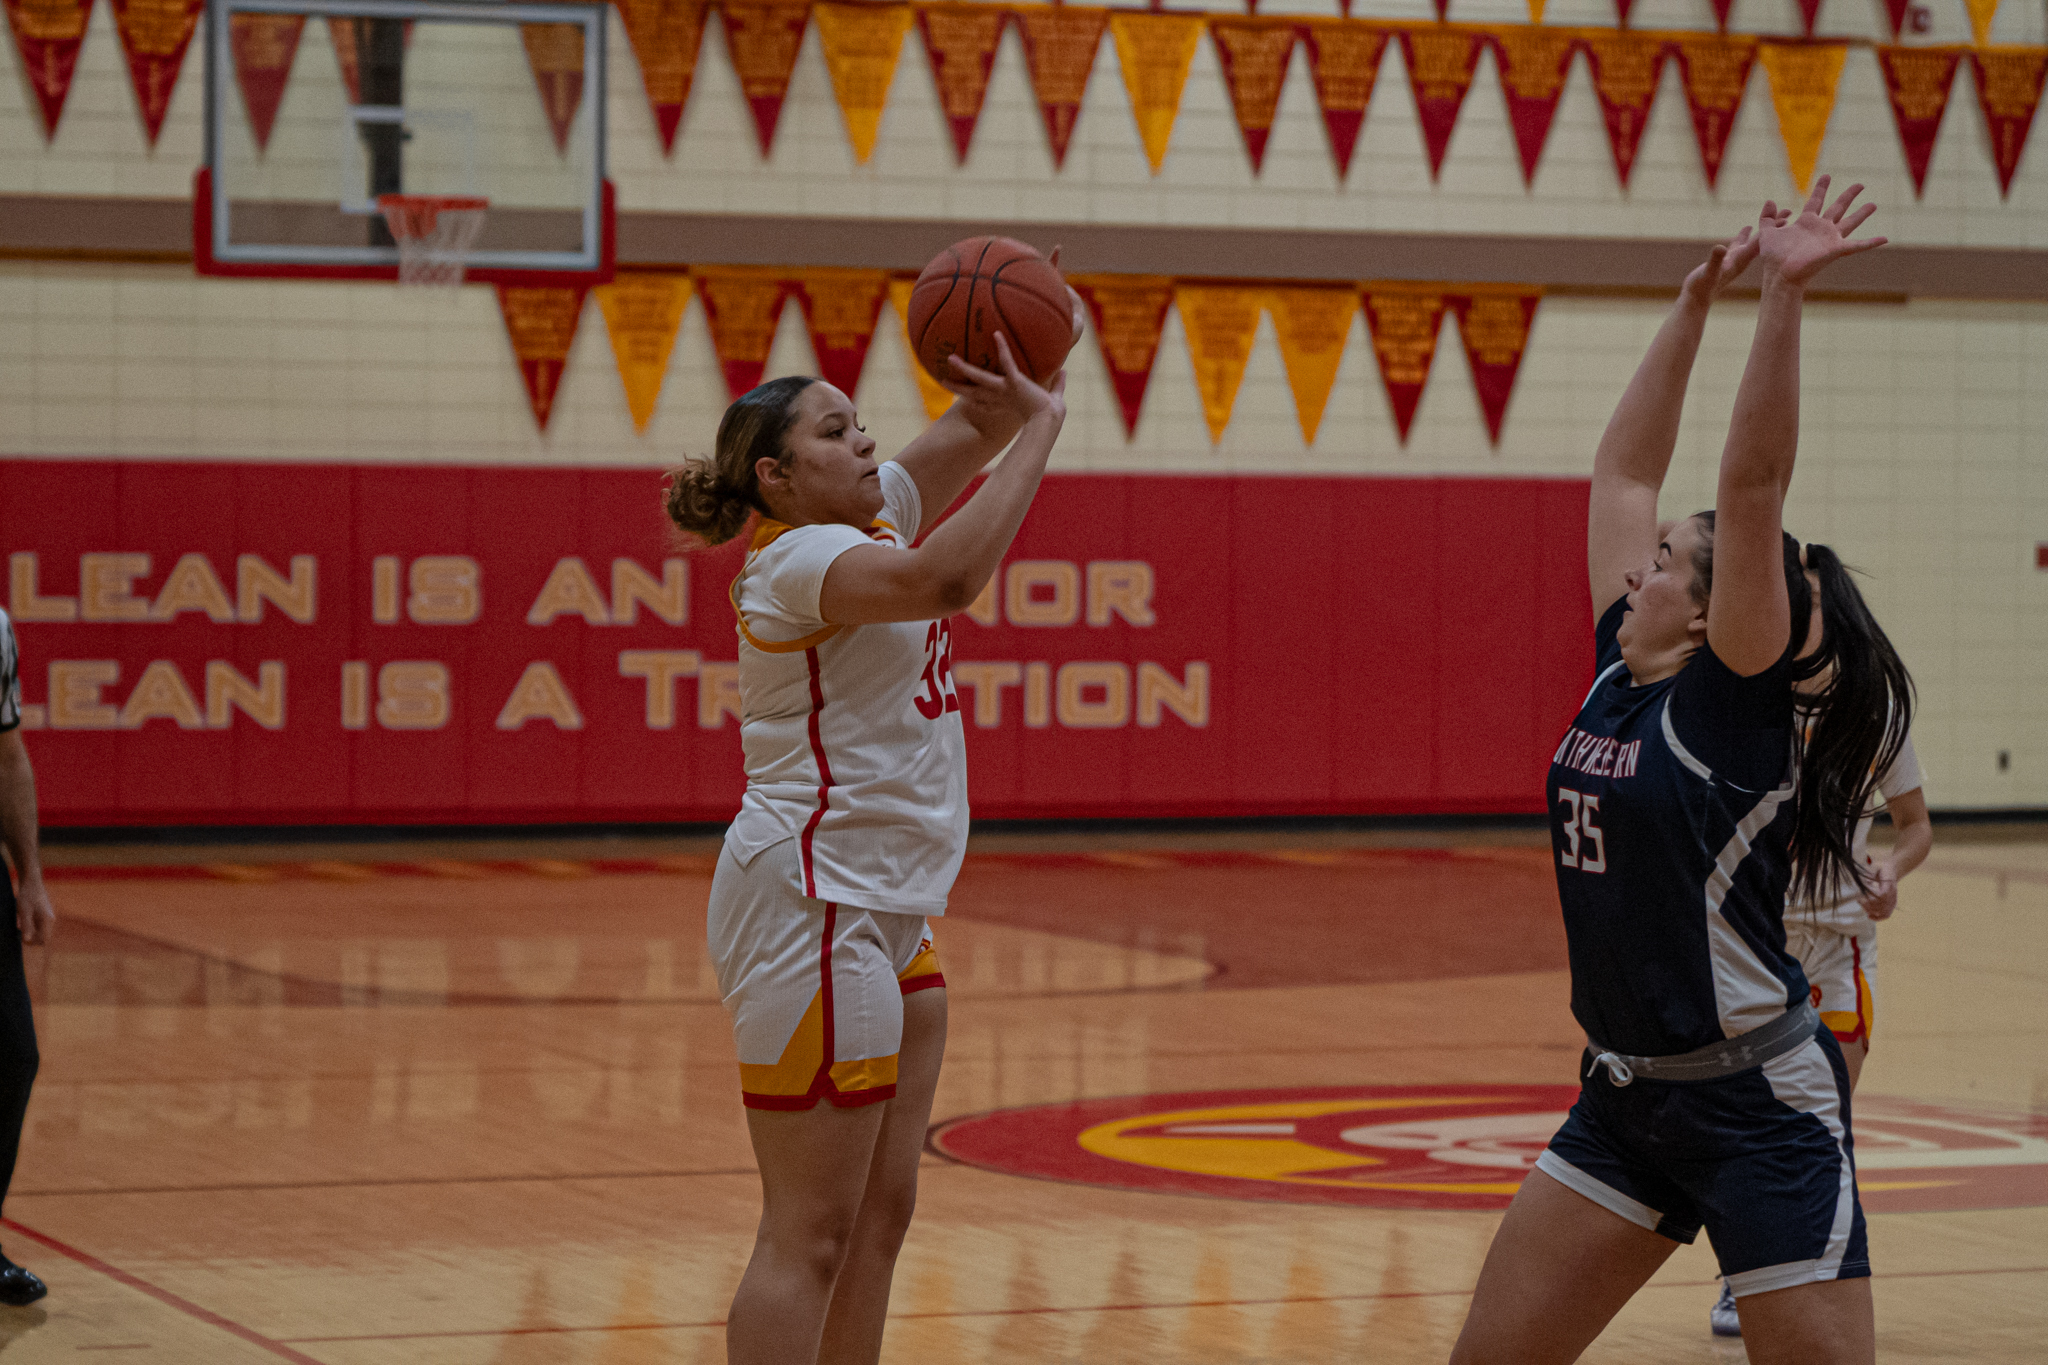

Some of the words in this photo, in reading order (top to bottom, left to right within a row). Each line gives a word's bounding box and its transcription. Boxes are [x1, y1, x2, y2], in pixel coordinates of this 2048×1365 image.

[373, 555, 481, 626] IS
[527, 556, 689, 626] AN
[341, 660, 452, 731] IS
[496, 661, 584, 731] A
[913, 615, 960, 721] 32
[1558, 786, 1607, 875] 35
